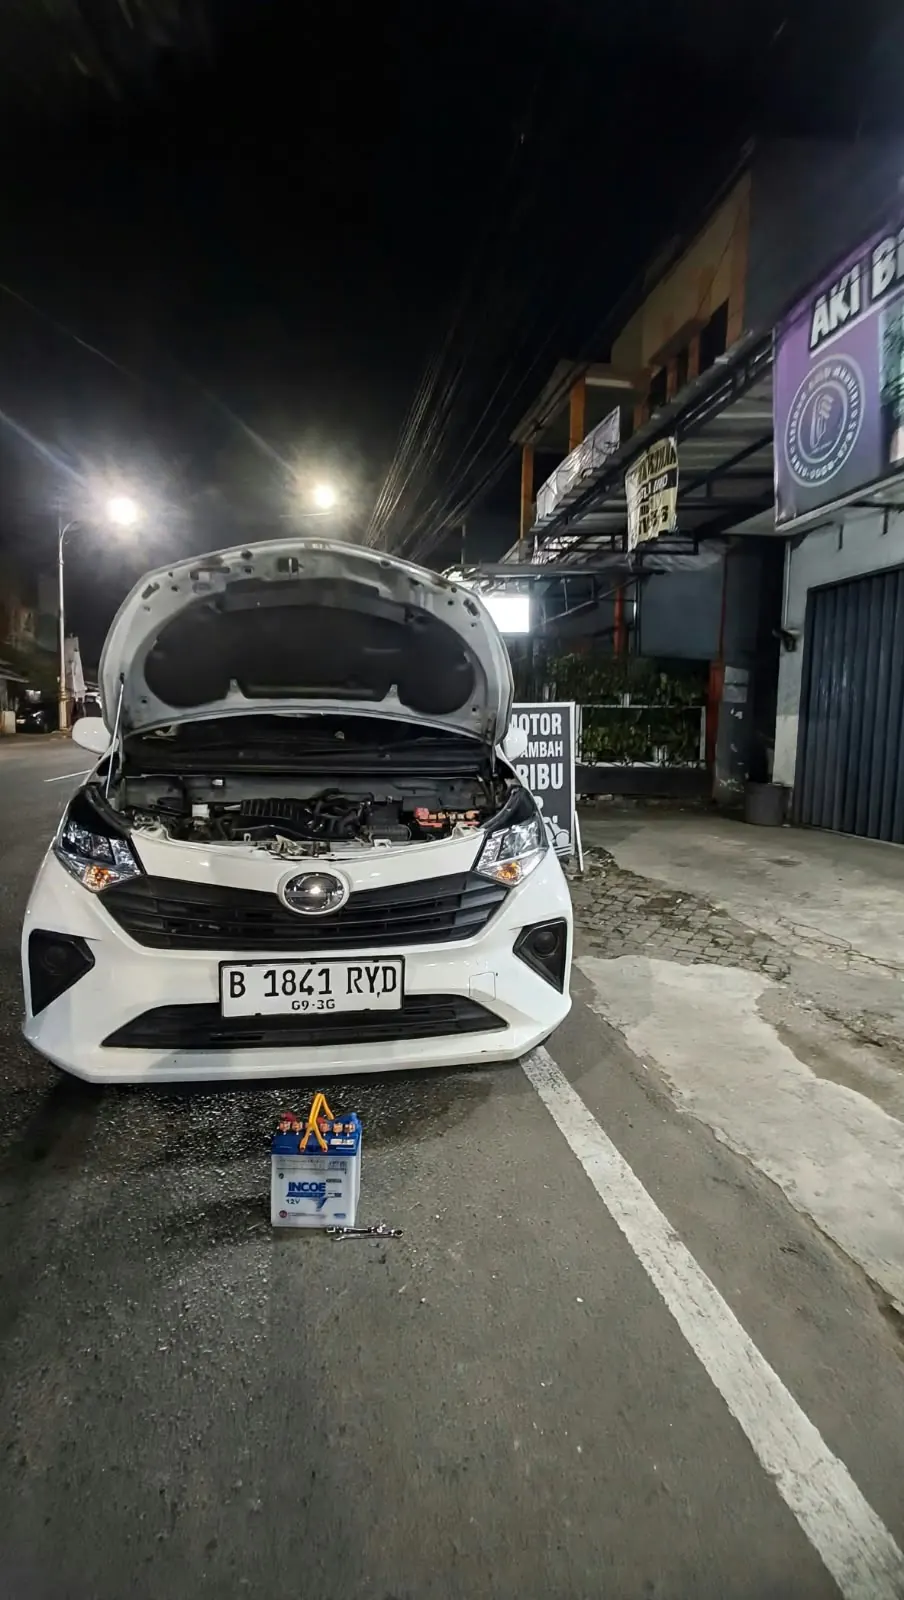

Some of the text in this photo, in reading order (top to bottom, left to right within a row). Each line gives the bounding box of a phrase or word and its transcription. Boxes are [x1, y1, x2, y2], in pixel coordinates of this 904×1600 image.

[810, 263, 860, 348] AKI
[516, 763, 563, 790] RIBU
[230, 966, 397, 998] B 1841 RYD
[288, 1182, 326, 1192] INCOE
